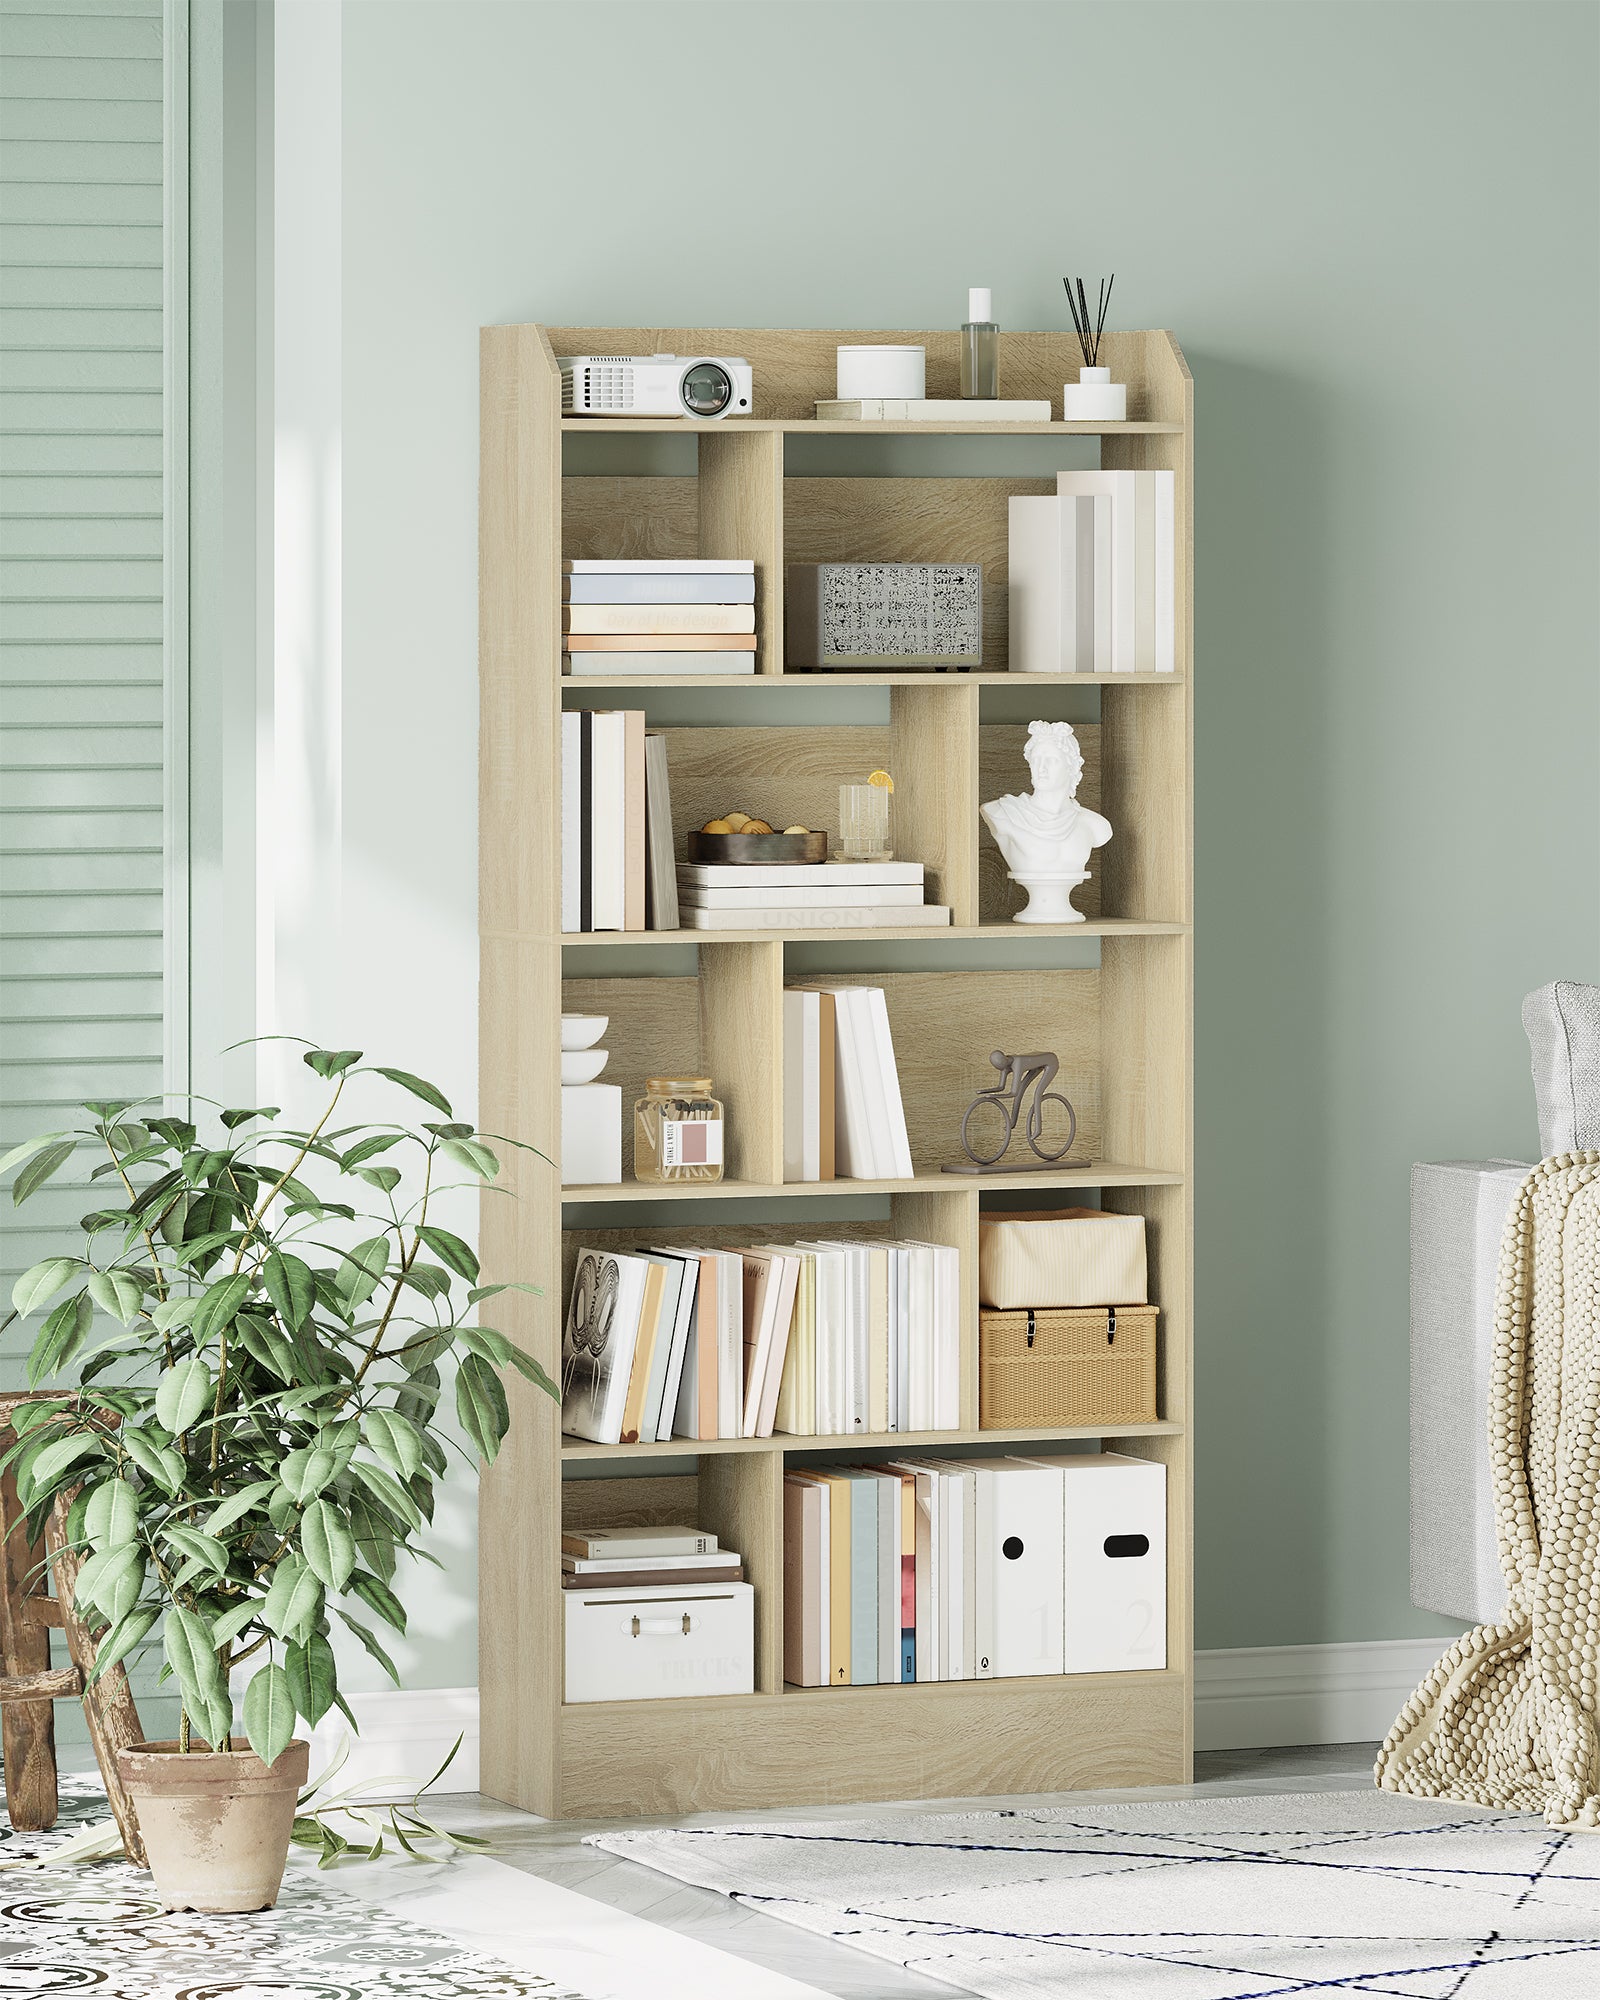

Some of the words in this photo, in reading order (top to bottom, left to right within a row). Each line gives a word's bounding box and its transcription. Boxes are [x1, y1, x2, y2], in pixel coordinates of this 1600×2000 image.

[607, 613, 635, 628] Day
[638, 613, 652, 627] of
[656, 613, 679, 626] the
[683, 613, 728, 628] design
[762, 910, 862, 928] UNION
[1031, 1601, 1055, 1660] 1
[1125, 1599, 1156, 1656] 2
[658, 1655, 744, 1681] TRUCKS
